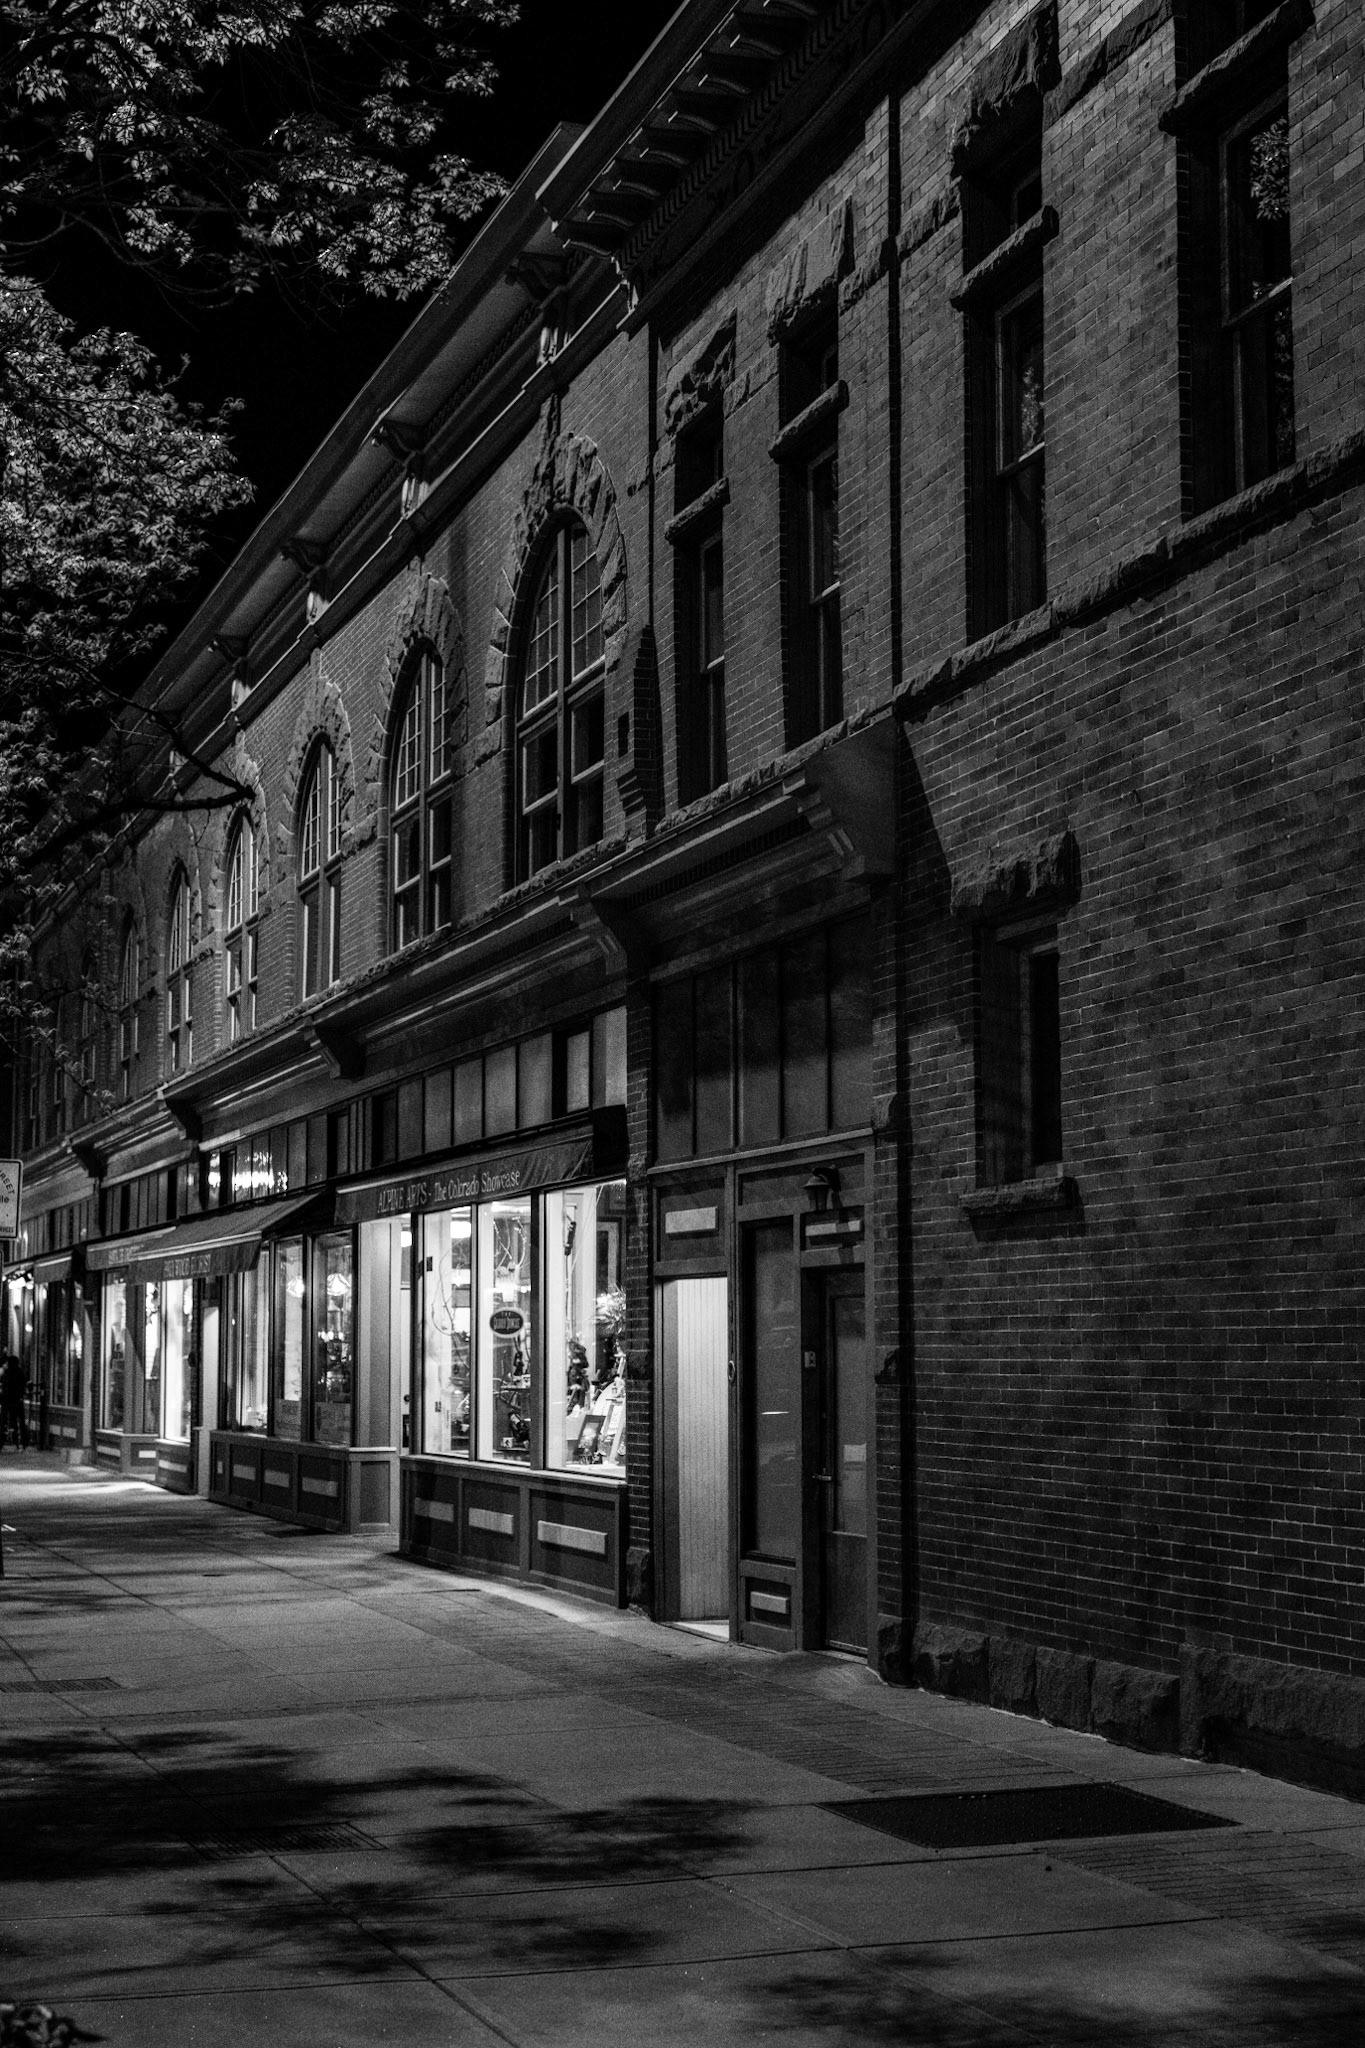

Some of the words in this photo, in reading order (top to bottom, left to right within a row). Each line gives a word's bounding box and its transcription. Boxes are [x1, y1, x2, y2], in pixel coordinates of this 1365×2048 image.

[377, 1187, 404, 1214] ALPINE
[405, 1181, 427, 1208] ARTS
[434, 1181, 447, 1202] The
[447, 1174, 480, 1200] Colorado
[481, 1170, 521, 1193] Showcase
